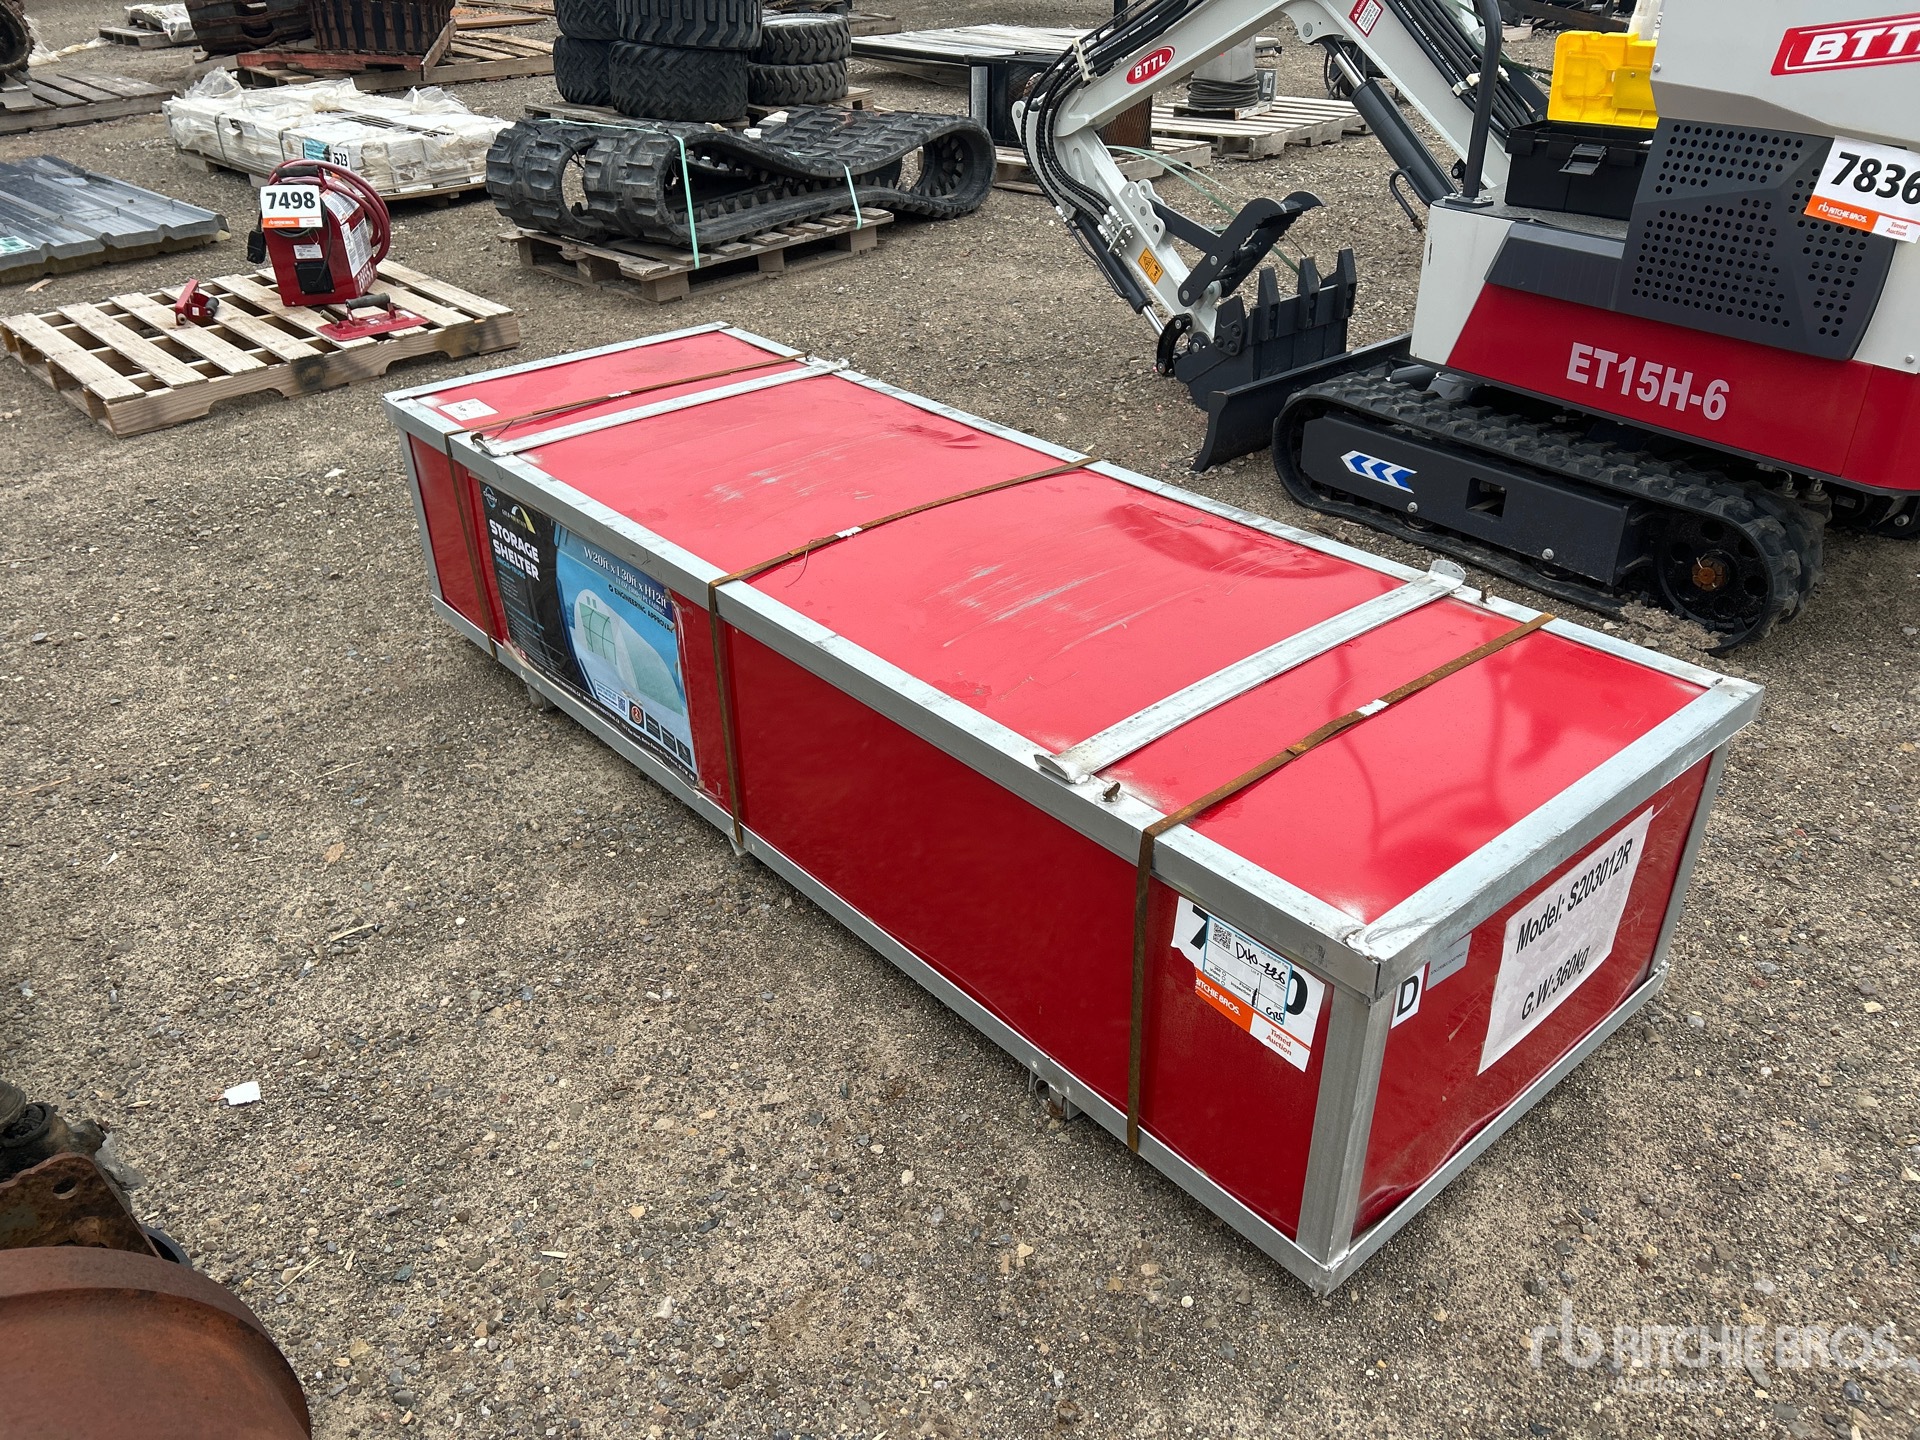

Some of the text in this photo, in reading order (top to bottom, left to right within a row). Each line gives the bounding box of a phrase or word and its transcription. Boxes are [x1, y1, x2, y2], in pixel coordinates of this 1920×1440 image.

[1802, 23, 1920, 63] BTT
[1134, 54, 1166, 80] BTTL
[1830, 151, 1920, 205] 7836
[266, 191, 316, 210] 7498
[1885, 227, 1907, 237] Auction
[1566, 342, 1730, 421] ET15H-6
[489, 518, 540, 564] STORAGE
[492, 538, 541, 582] SHELTER
[583, 546, 609, 570] W20ft
[644, 583, 667, 609] H12ft
[614, 587, 647, 615] ENGINEERING
[1516, 838, 1634, 954] Model: S203012R
[1218, 995, 1241, 1016] BROS.
[1396, 974, 1419, 1018] D
[1266, 1035, 1292, 1056] Auction
[1270, 1028, 1292, 1048] Timed
